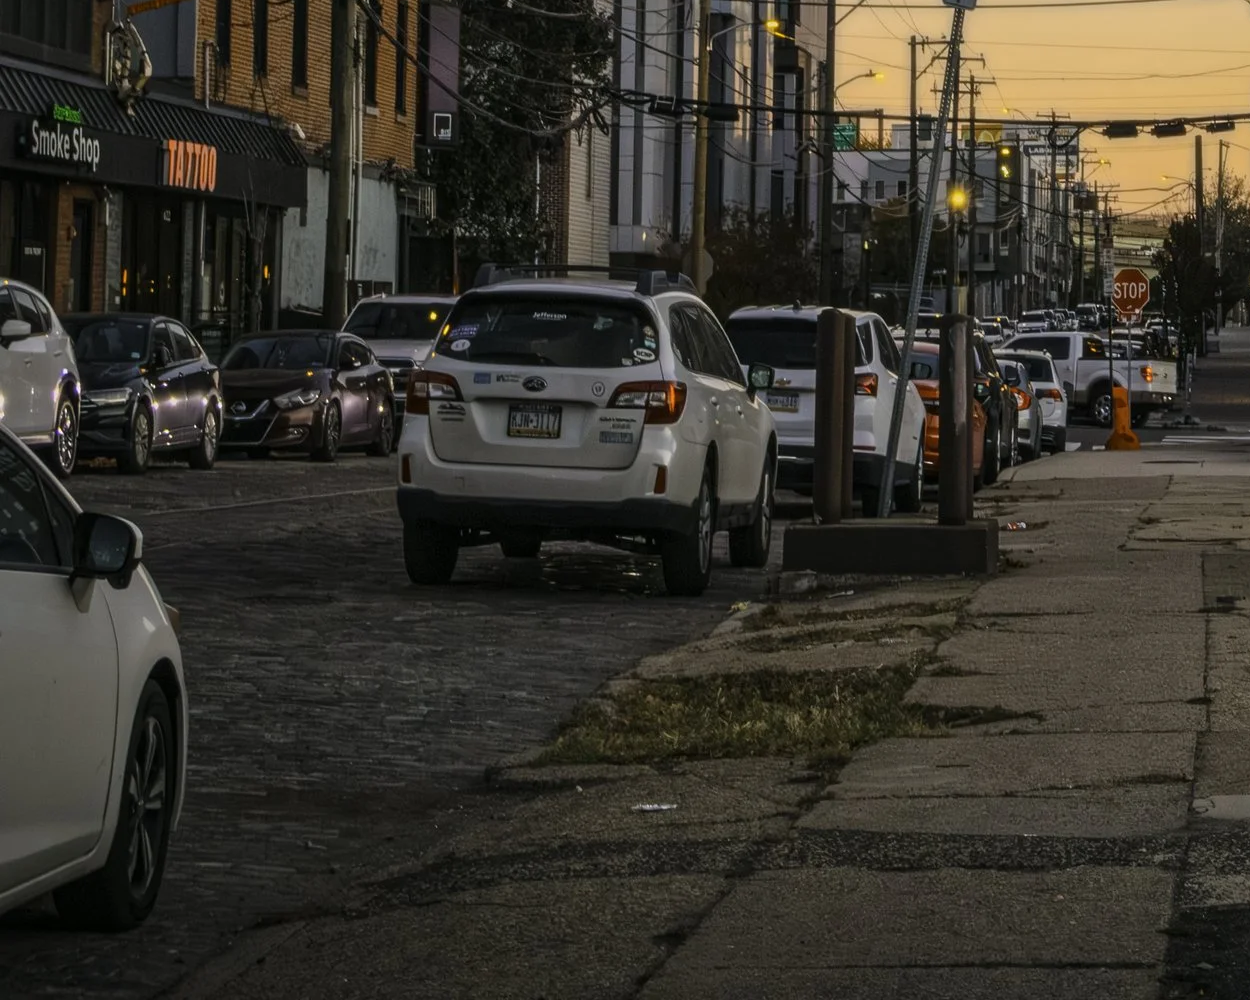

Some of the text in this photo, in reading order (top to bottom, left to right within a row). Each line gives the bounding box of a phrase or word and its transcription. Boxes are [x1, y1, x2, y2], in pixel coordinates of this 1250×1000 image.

[32, 119, 100, 173] Smoke Shop
[168, 138, 217, 192] TATTOO
[1113, 282, 1147, 299] STOP
